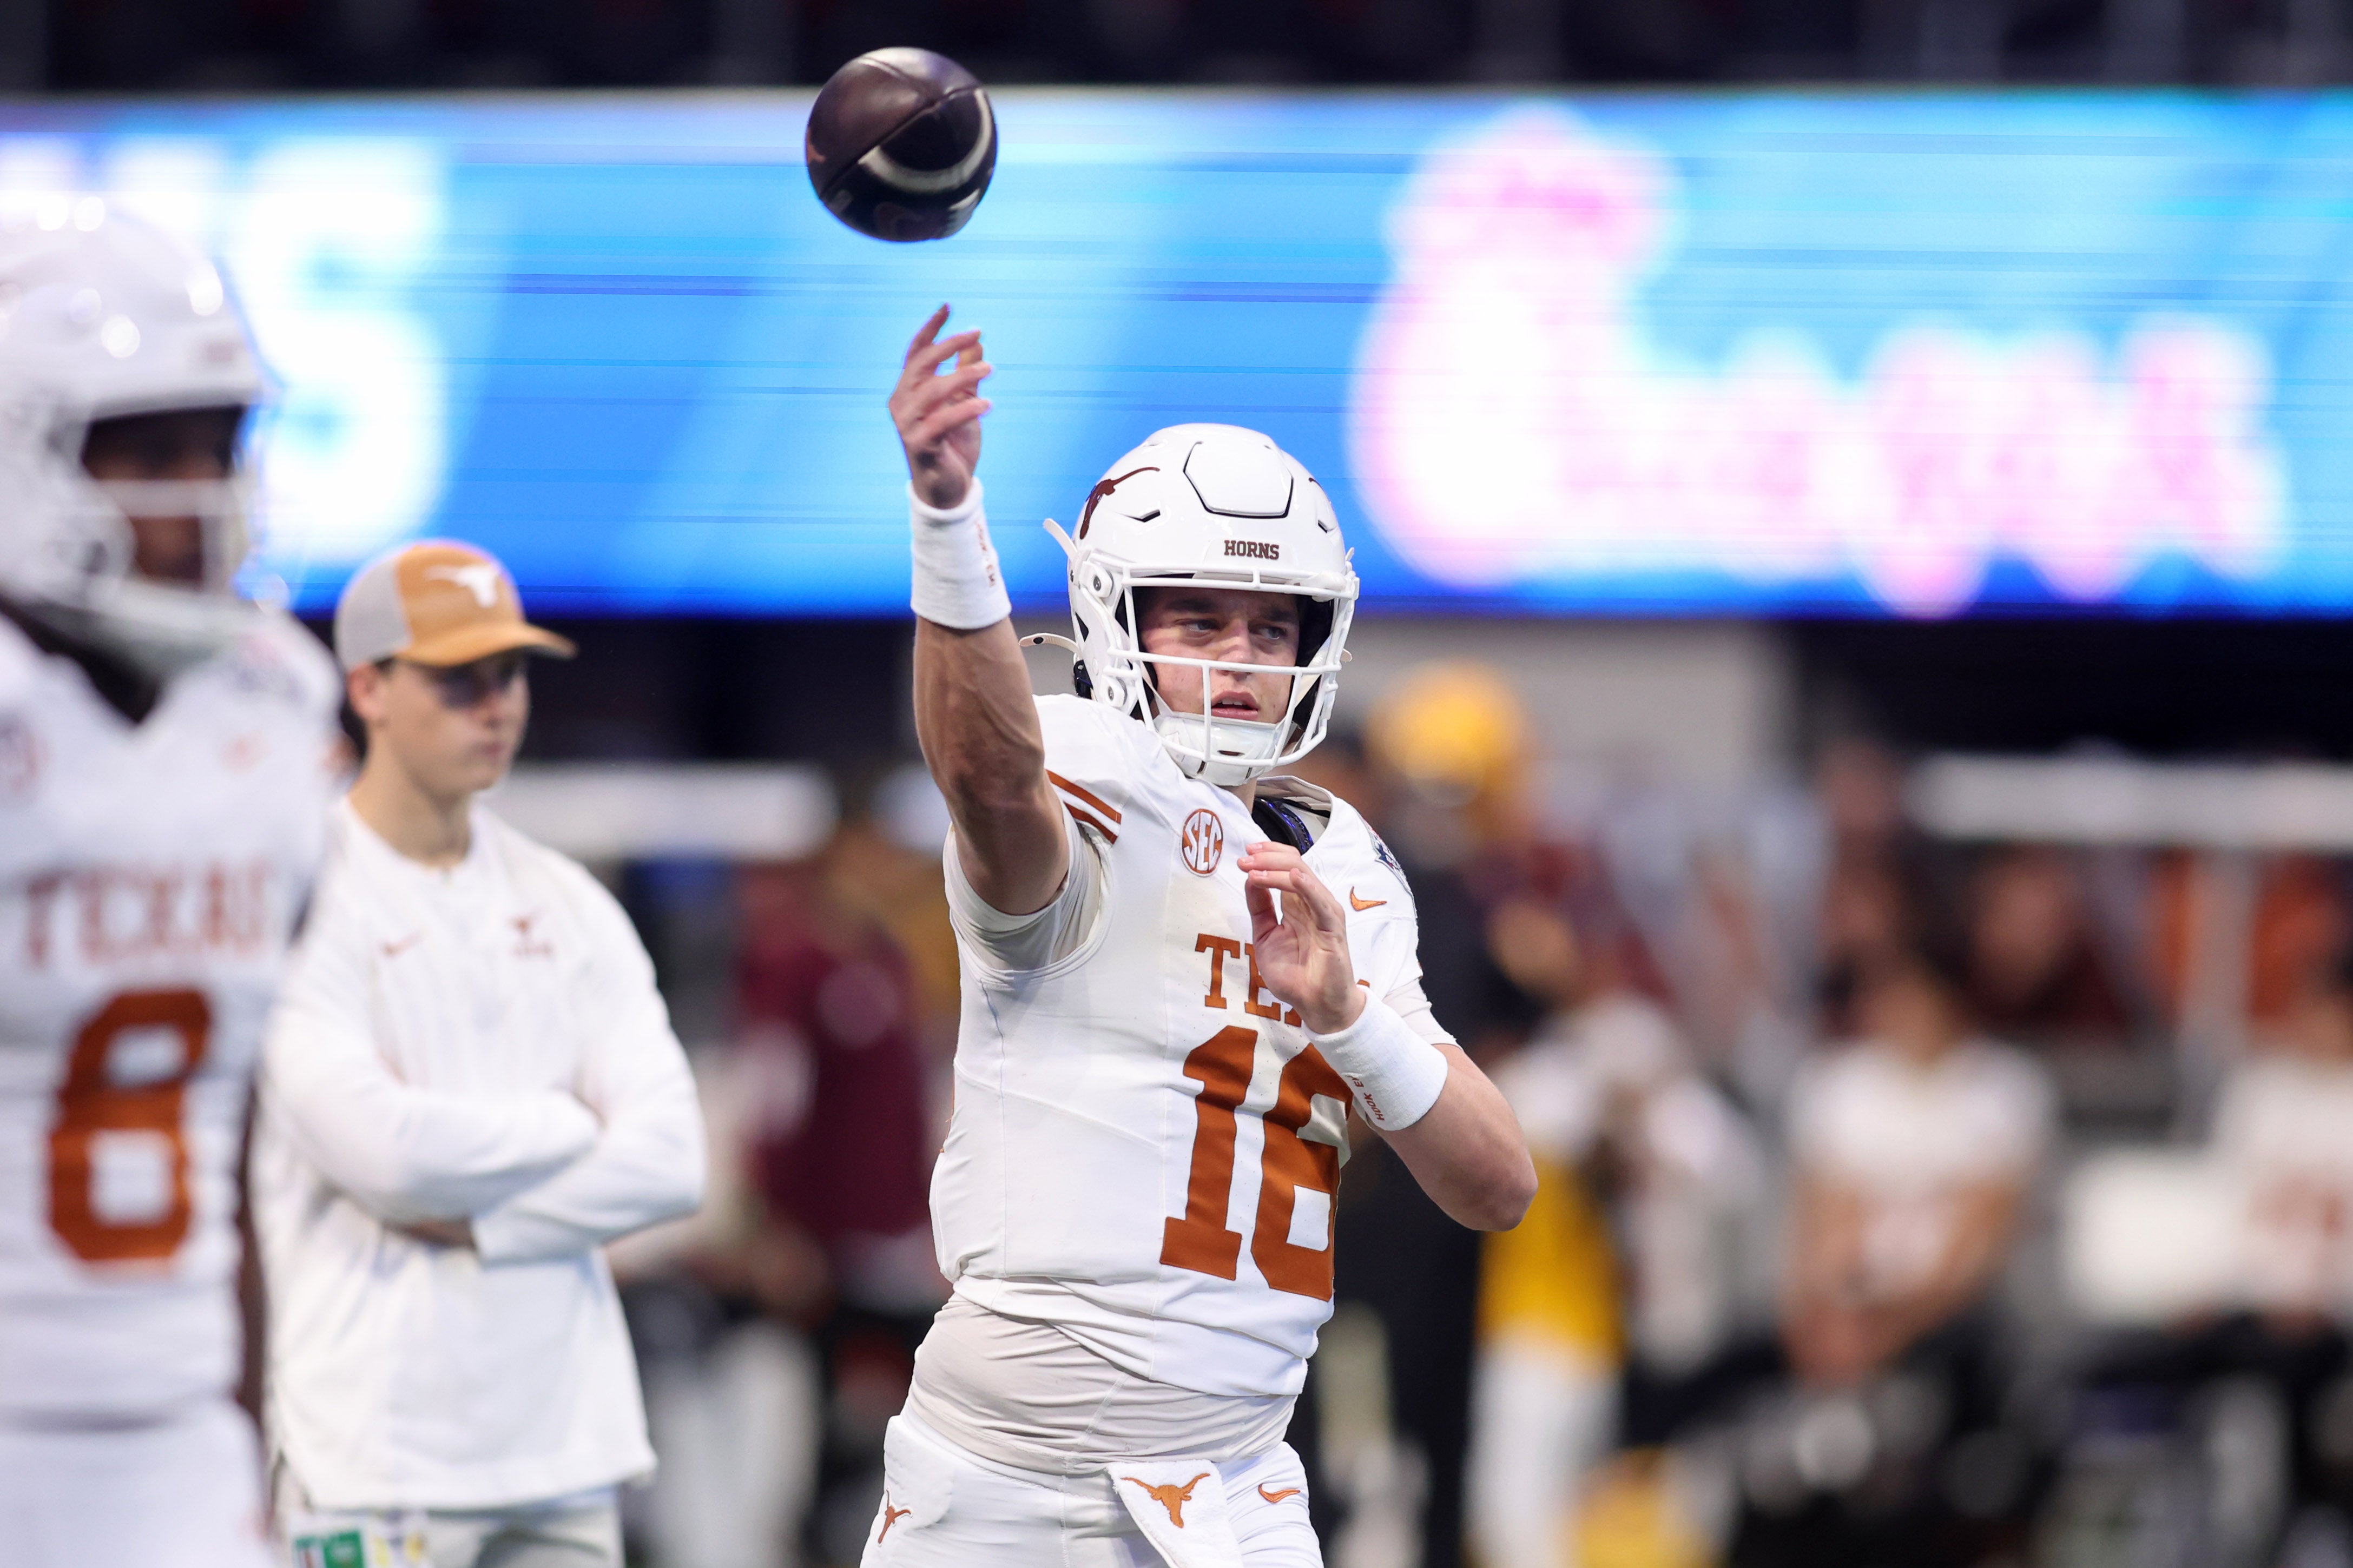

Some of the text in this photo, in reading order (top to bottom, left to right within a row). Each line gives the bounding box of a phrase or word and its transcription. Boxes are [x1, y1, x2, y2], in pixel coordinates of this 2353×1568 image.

[1224, 540, 1280, 560] HORNS
[1183, 810, 1222, 871] SEC
[49, 985, 213, 1263] 8
[1363, 1093, 1385, 1121] HOOK
[1160, 1025, 1353, 1302] 16
